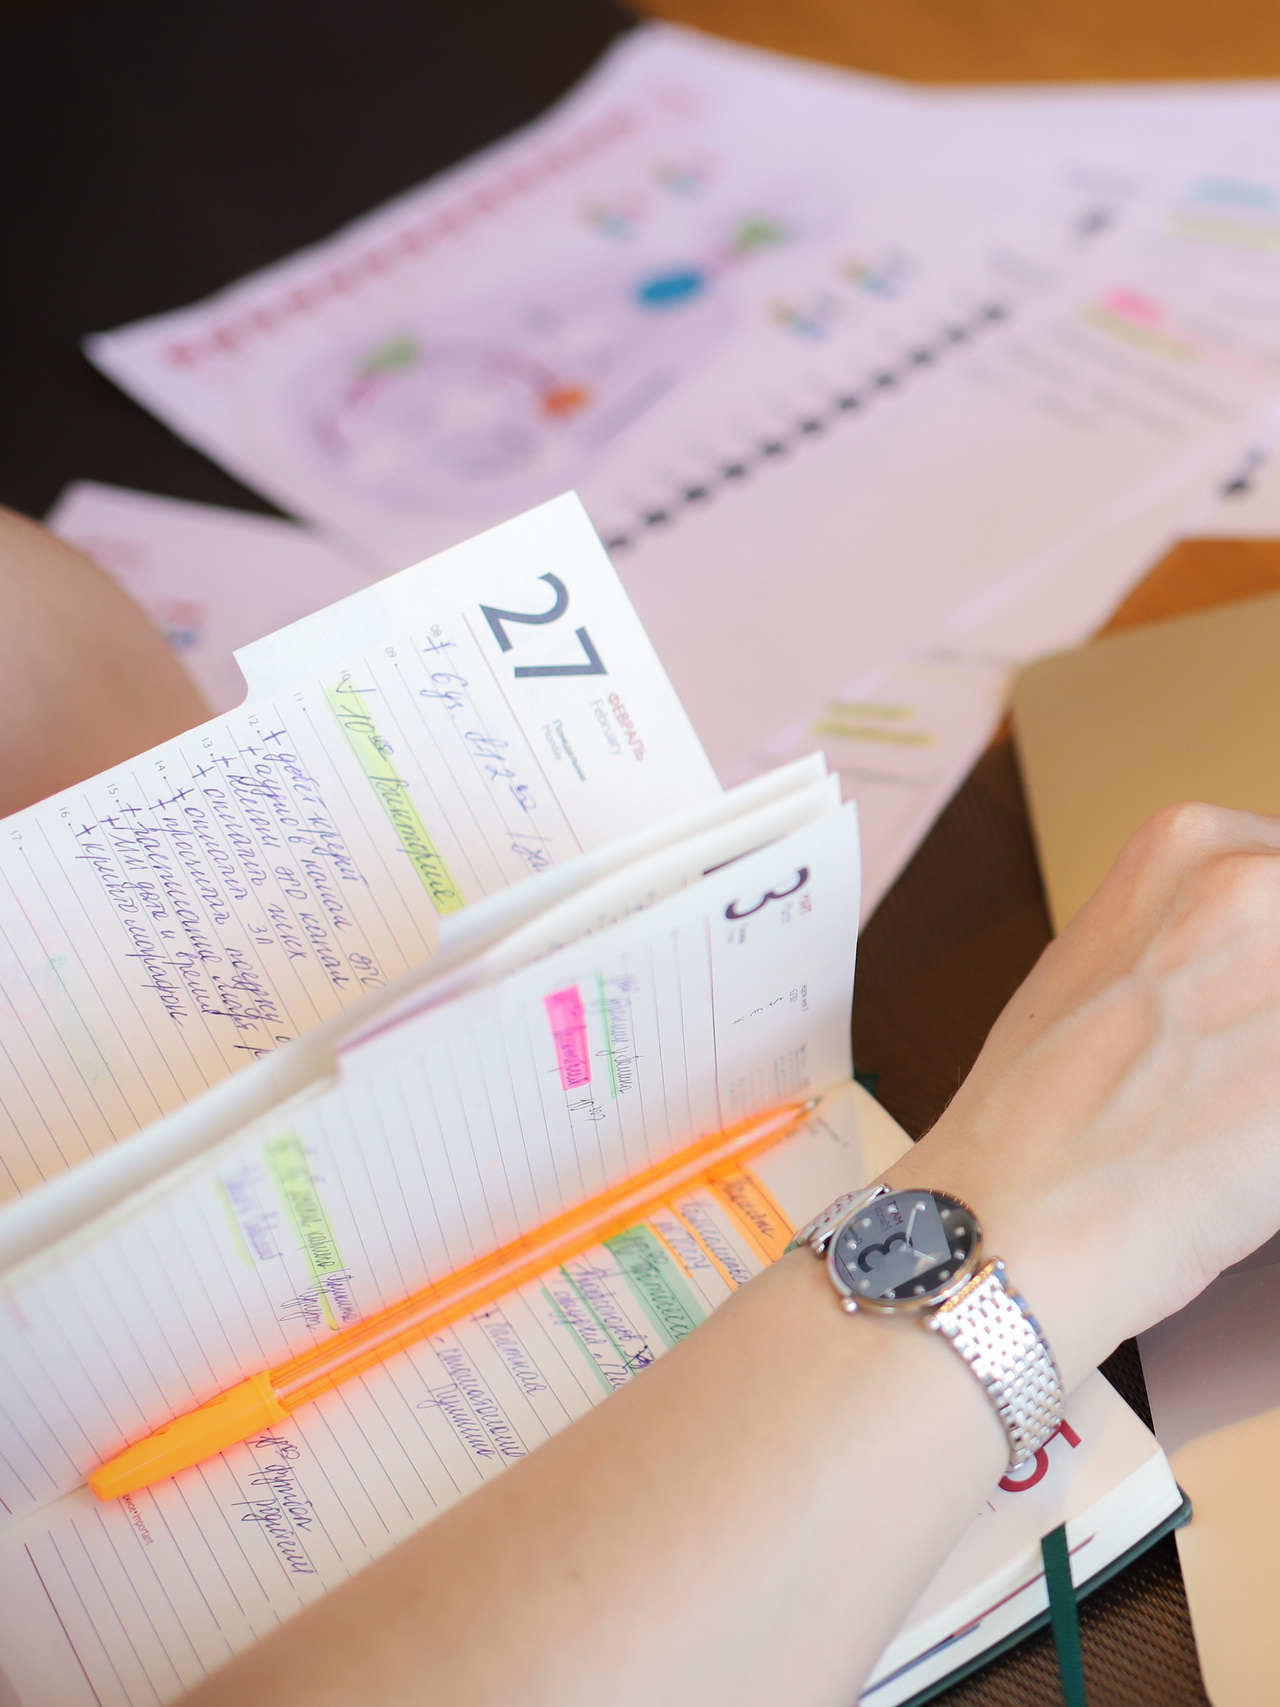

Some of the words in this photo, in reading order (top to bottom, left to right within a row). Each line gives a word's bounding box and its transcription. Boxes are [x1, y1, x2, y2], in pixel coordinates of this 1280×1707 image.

[429, 624, 441, 637] 08
[480, 573, 605, 678] 27
[384, 646, 396, 658] 09
[293, 691, 304, 702] 11
[247, 714, 258, 726] 12
[590, 699, 620, 755] February
[608, 693, 643, 761] ФЕВРАЛЬ
[200, 737, 212, 748] 13
[541, 724, 561, 760] Monday
[552, 719, 585, 781] Понедельник
[154, 760, 165, 771] 14
[106, 783, 118, 795] 15
[58, 806, 70, 818] 16
[9, 830, 22, 840] 17
[725, 867, 808, 919] 3
